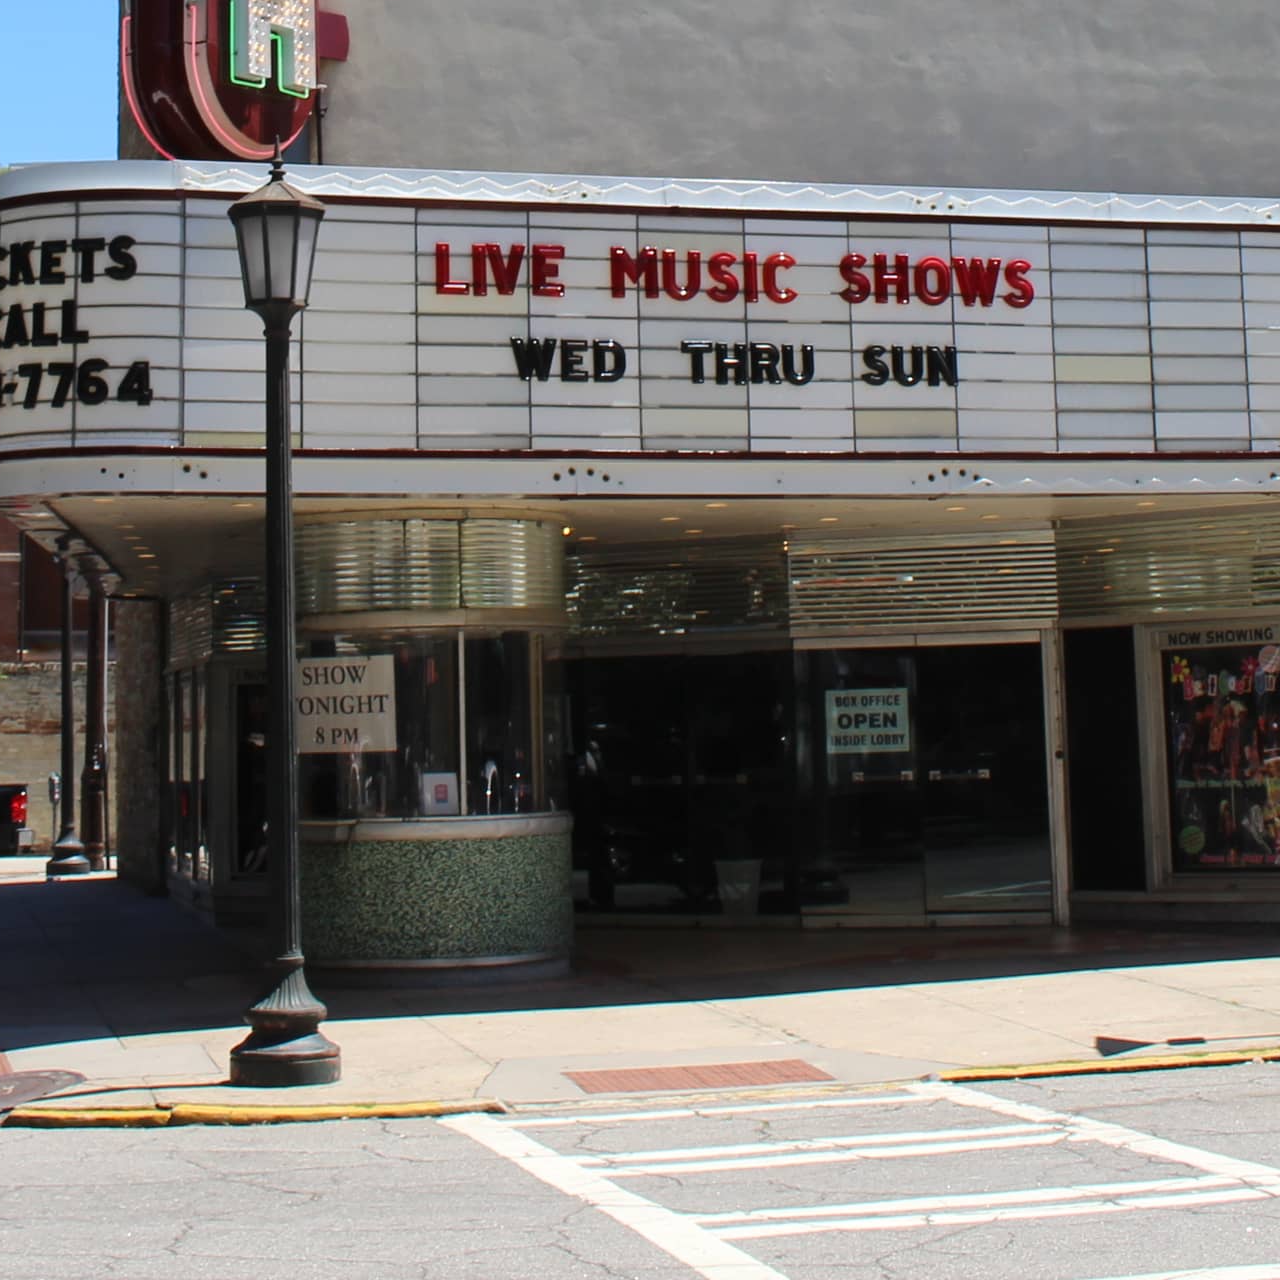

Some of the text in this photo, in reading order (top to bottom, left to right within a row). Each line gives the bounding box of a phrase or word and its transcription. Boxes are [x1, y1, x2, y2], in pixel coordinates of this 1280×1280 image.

[435, 242, 1035, 308] LIVE MUSIC SHOWS
[510, 337, 959, 387] WED THRU SUN
[1168, 627, 1274, 646] NOW SHOWING
[302, 666, 367, 686] SHOW
[296, 694, 389, 716] ONIGHT
[834, 694, 901, 708] BOX OFFICE
[837, 711, 898, 729] OPEN
[315, 726, 359, 745] 8 PM
[831, 733, 905, 747] INSIDE LOBBY
